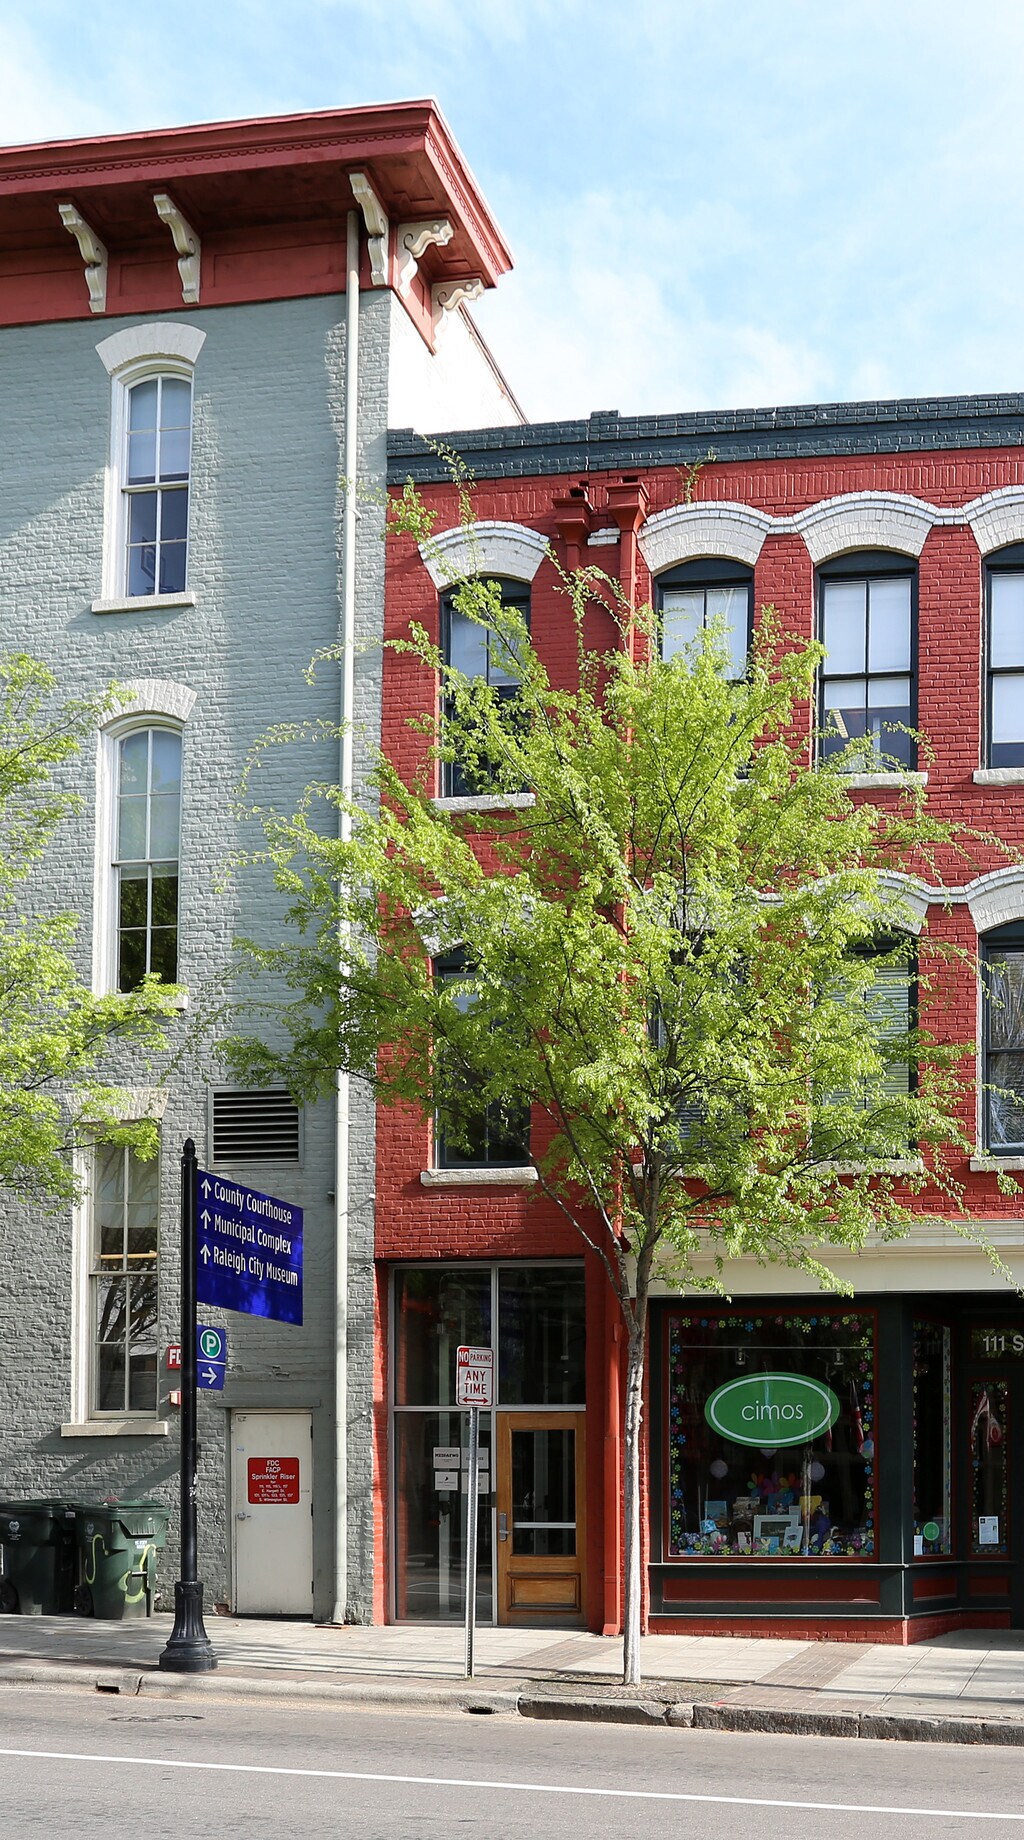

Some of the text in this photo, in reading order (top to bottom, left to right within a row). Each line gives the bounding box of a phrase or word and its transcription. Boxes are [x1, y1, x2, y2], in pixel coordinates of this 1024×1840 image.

[214, 1181, 292, 1225] County Courthouse
[214, 1213, 292, 1255] Municipal Complex
[213, 1245, 298, 1286] Raleigh City Museum
[206, 1334, 217, 1353] P
[983, 1336, 1005, 1351] 111
[459, 1351, 491, 1364] NO PARKING
[465, 1370, 486, 1382] ANY
[464, 1383, 487, 1395] TIME
[741, 1400, 804, 1421] cimos
[251, 1473, 278, 1481] Sprinkler
